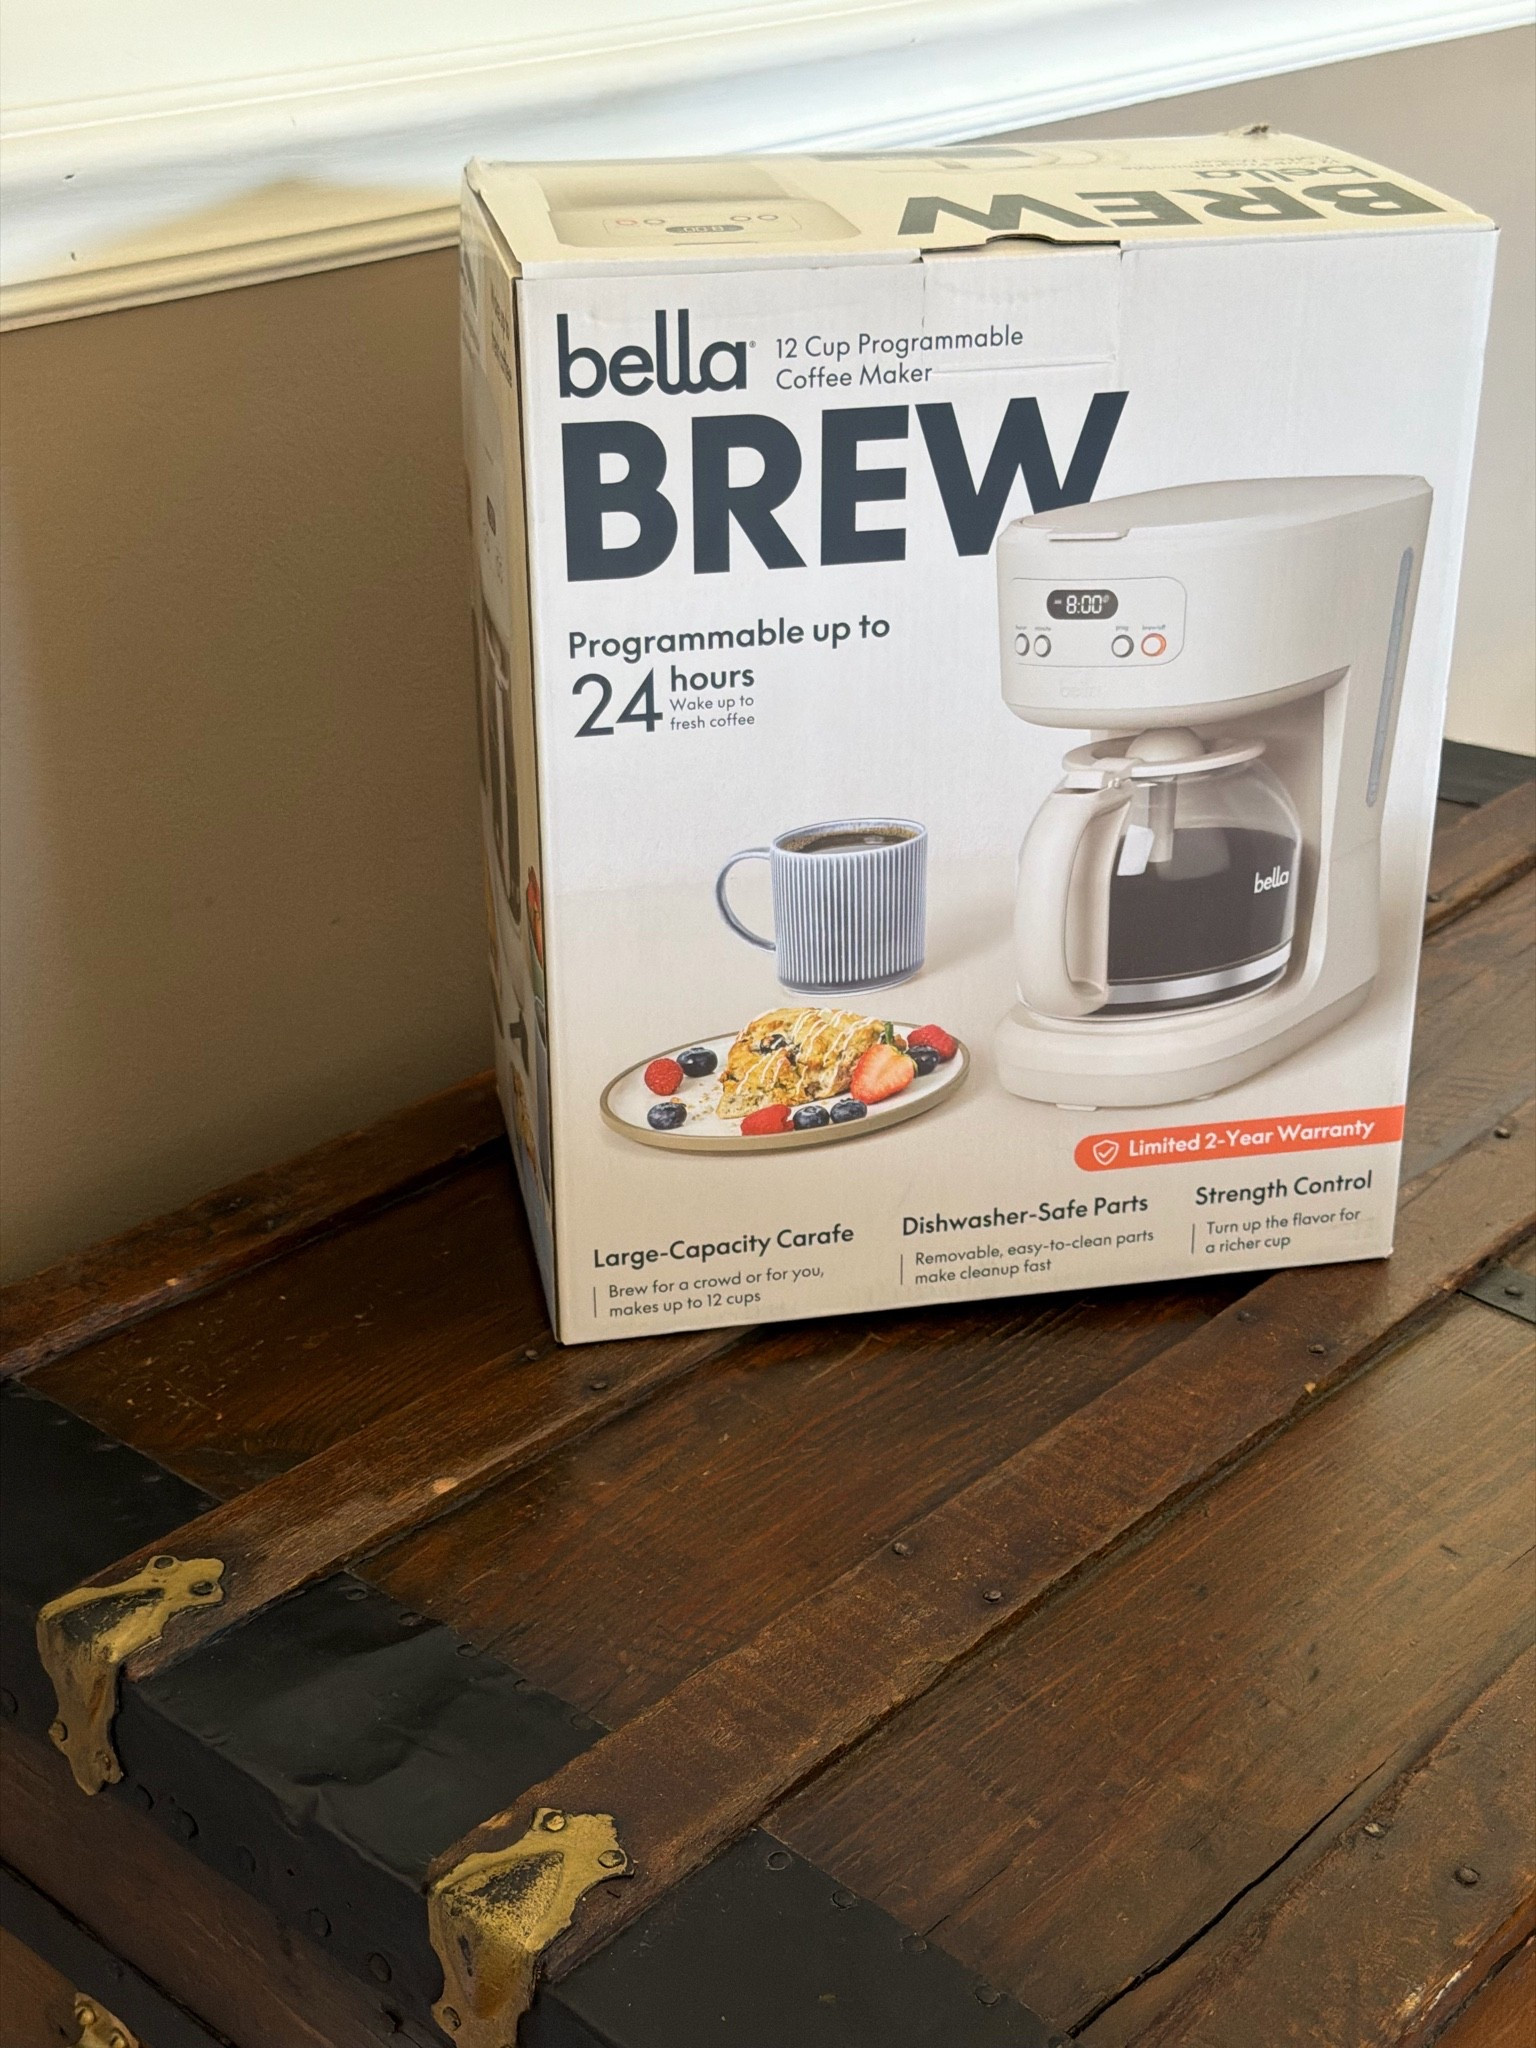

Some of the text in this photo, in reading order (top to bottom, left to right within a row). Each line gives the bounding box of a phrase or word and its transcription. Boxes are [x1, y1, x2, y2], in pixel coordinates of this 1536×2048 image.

[1192, 165, 1379, 183] bella
[898, 181, 1445, 236] BREW
[556, 308, 748, 399] bella
[776, 324, 1024, 362] 12 Cup Programmable
[775, 362, 933, 390] Coffee Maker
[561, 390, 1130, 582] BREW
[568, 614, 891, 665] Programmable up to
[669, 665, 755, 692] hours
[571, 667, 664, 738] 24
[669, 694, 755, 712] Wake up to
[669, 713, 756, 731] fresh coffee
[1253, 864, 1290, 894] bella
[1128, 1119, 1375, 1158] Limited 2-Year Warranty
[1195, 1169, 1373, 1207] Strength Control
[902, 1195, 1148, 1237] Dishwasher-Safe Parts
[1206, 1208, 1361, 1236] Turn up the flavor for
[594, 1223, 855, 1270] Large-Capacity Carafe
[915, 1229, 1154, 1266] Removable, easy-to-clean parts
[1205, 1235, 1291, 1254] a richer cup
[608, 1266, 825, 1299] Brew for a crowd or for you,
[914, 1258, 1052, 1285] make cleanup fast
[609, 1290, 761, 1318] makes up to 12 cups
